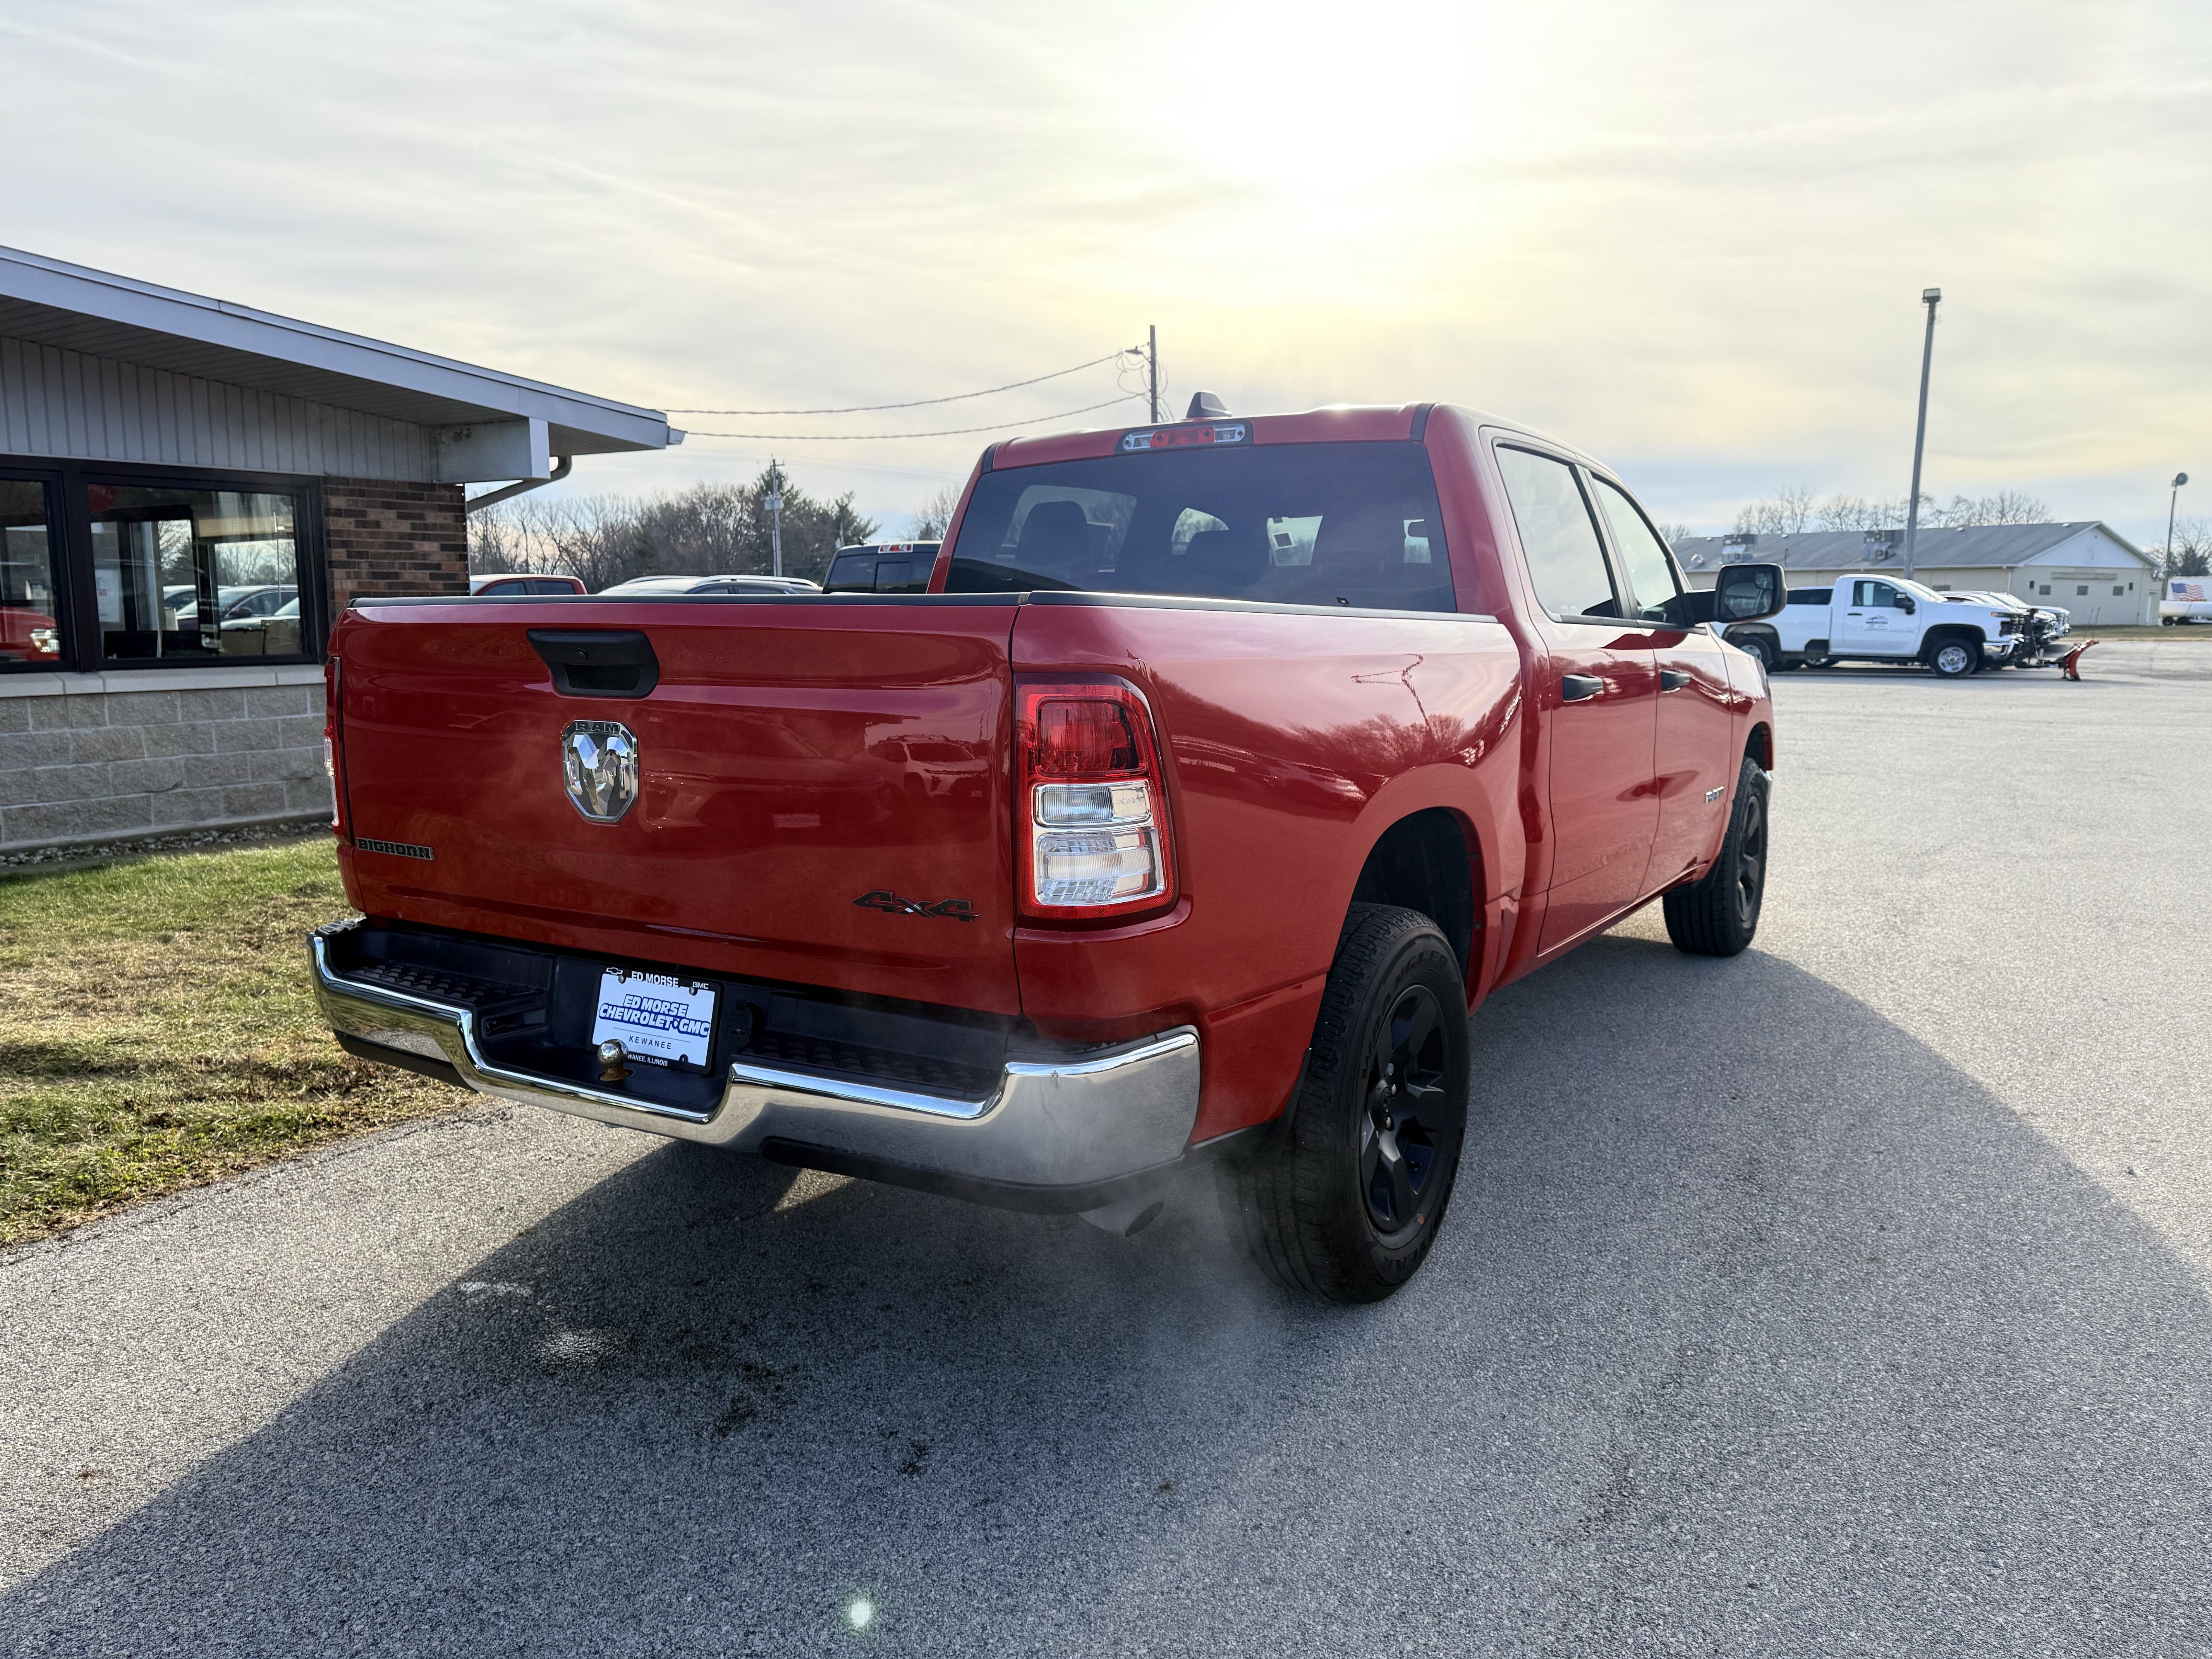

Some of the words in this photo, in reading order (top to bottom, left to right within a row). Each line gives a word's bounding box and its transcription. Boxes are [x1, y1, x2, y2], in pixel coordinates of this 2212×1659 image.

[575, 722, 620, 733] RAM
[356, 837, 434, 860] BIGHORN
[631, 971, 643, 981] ED
[646, 973, 679, 987] MORSE
[623, 994, 641, 1009] ED
[641, 996, 689, 1018] MORSE
[629, 1035, 672, 1049] KEWANEE
[628, 1053, 646, 1063] WANEE,
[647, 1057, 668, 1066] ILLINOIS
